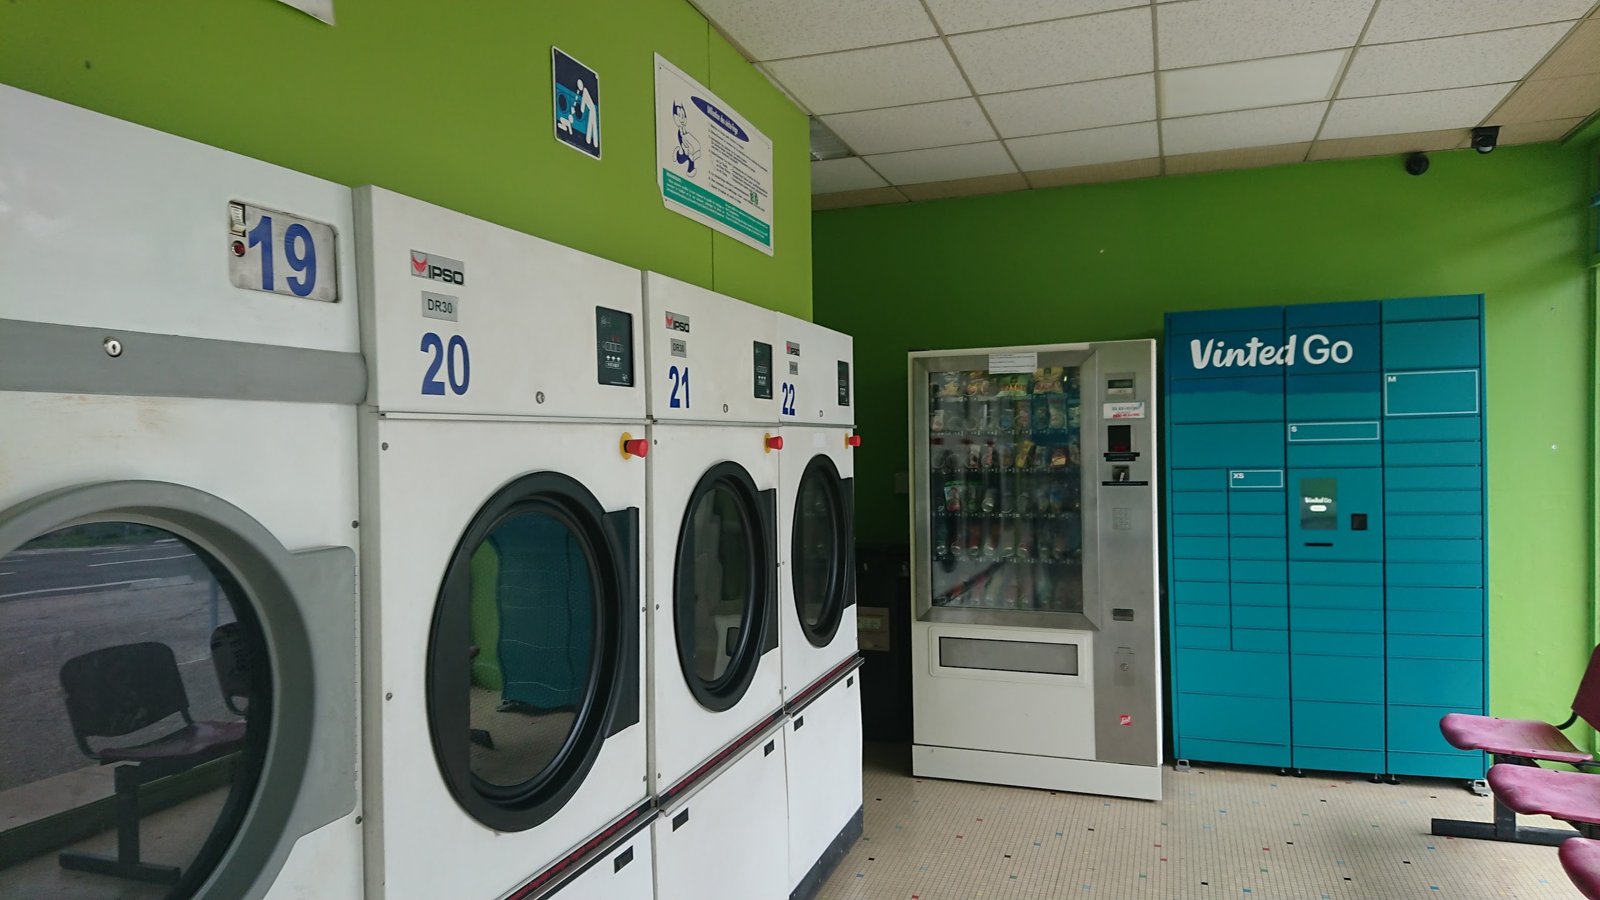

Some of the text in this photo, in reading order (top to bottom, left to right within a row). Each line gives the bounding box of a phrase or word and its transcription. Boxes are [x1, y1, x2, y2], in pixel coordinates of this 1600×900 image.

[248, 215, 317, 297] 19
[428, 264, 464, 286] IPSO
[427, 298, 453, 314] DR30
[673, 319, 690, 333] IPSO
[420, 332, 470, 396] 20
[1190, 334, 1354, 370] Vinted Go
[669, 365, 690, 409] 21
[782, 382, 796, 416] 22
[1291, 425, 1298, 433] S
